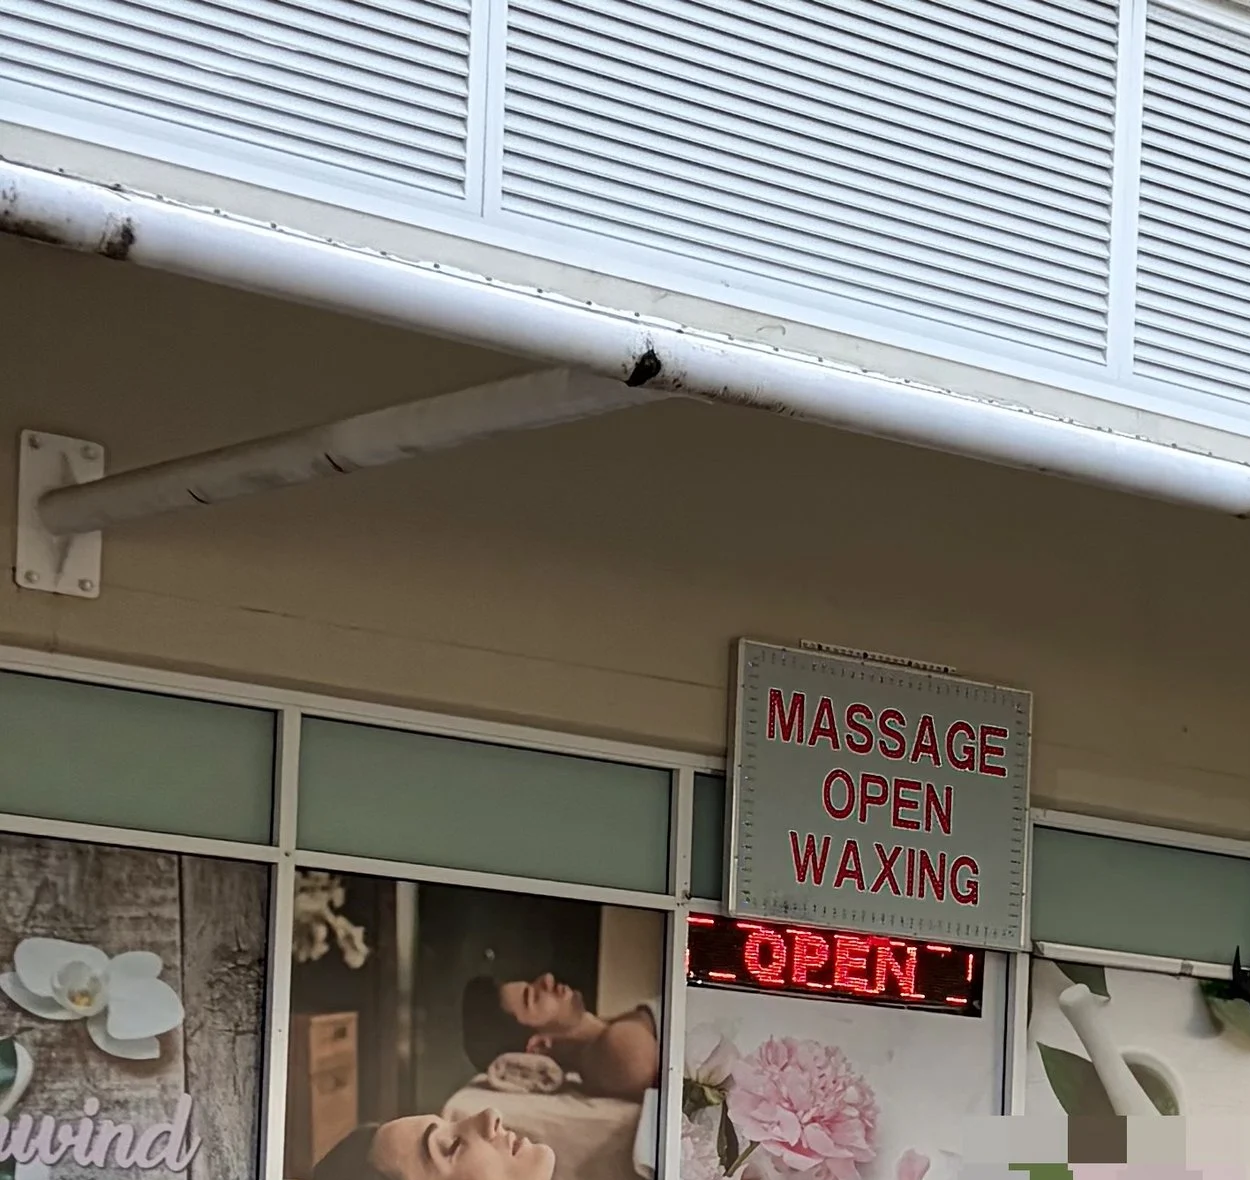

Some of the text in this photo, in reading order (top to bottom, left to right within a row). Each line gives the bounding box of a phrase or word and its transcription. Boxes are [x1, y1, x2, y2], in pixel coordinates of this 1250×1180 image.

[766, 687, 1010, 778] MASSAGE
[821, 767, 954, 836] OPEN
[789, 831, 980, 906] WAXING
[744, 928, 919, 996] OPEN
